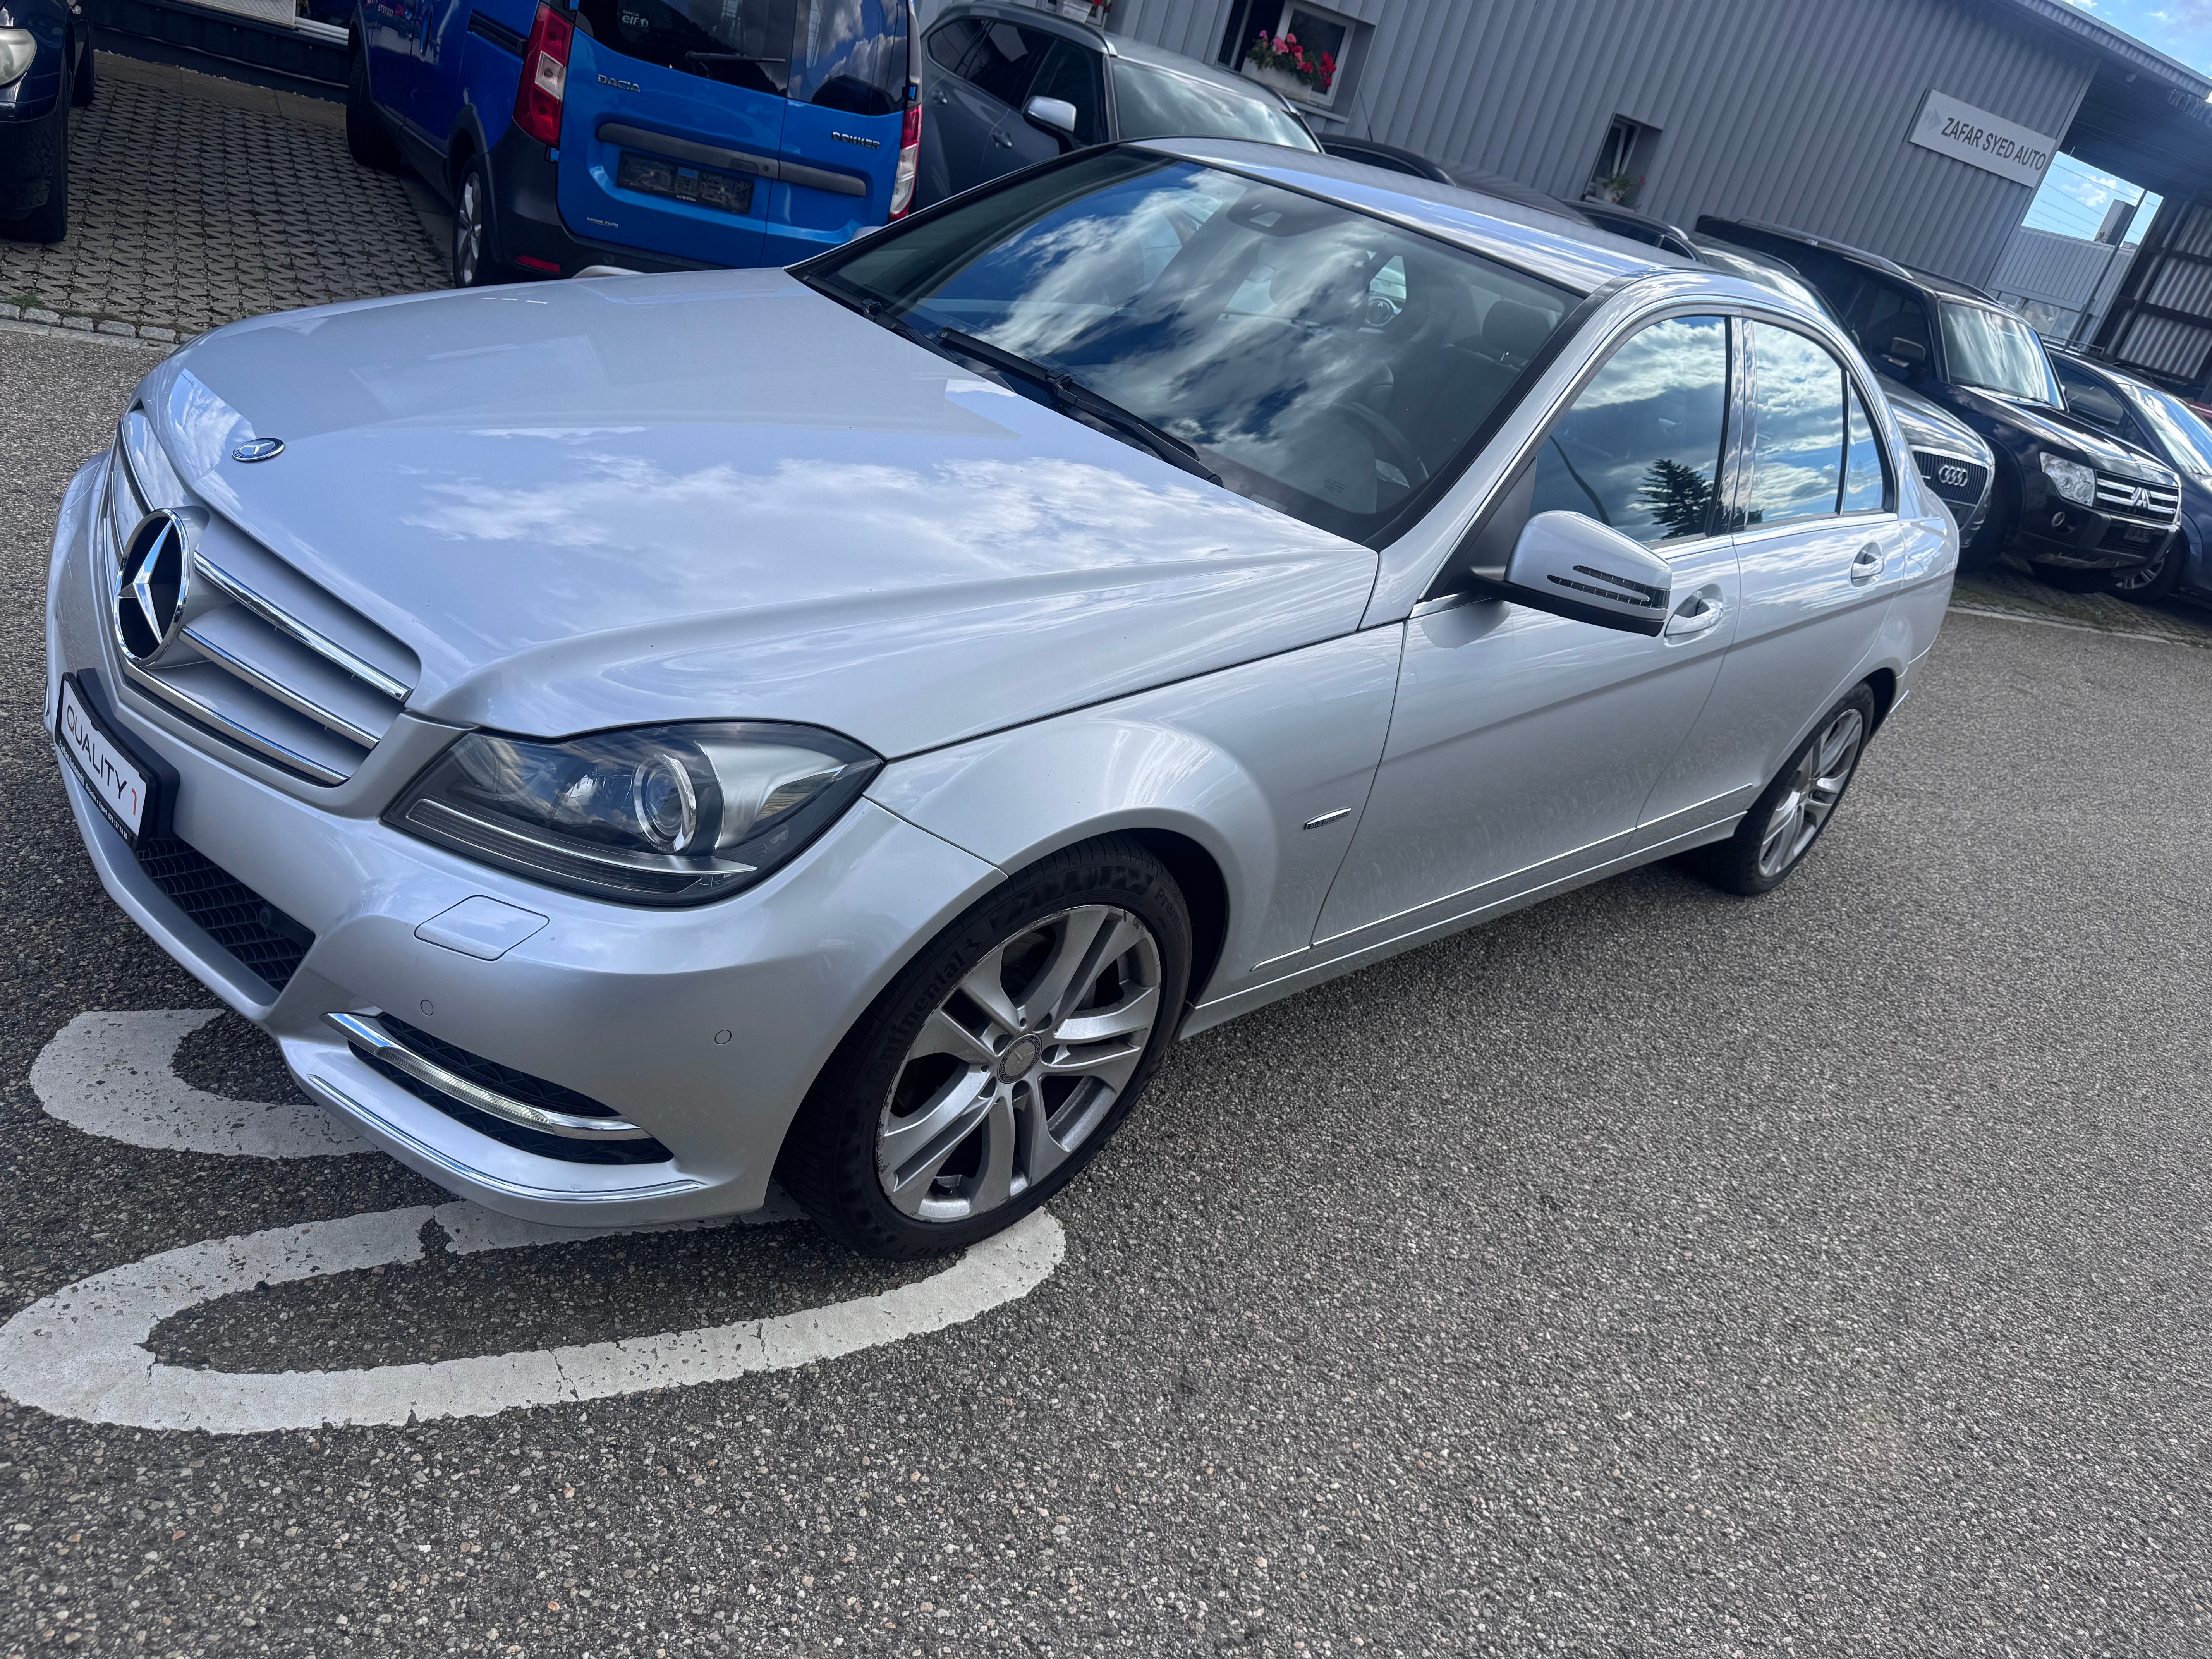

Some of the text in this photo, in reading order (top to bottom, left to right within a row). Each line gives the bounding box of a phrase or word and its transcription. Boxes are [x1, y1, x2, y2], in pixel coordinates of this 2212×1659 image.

[598, 74, 640, 92] DACIA
[833, 132, 880, 150] DOKKER
[1941, 117, 2046, 170] ZAFAR SYED AUTO
[67, 704, 127, 800] QUALITY
[869, 950, 966, 1081] Continental
